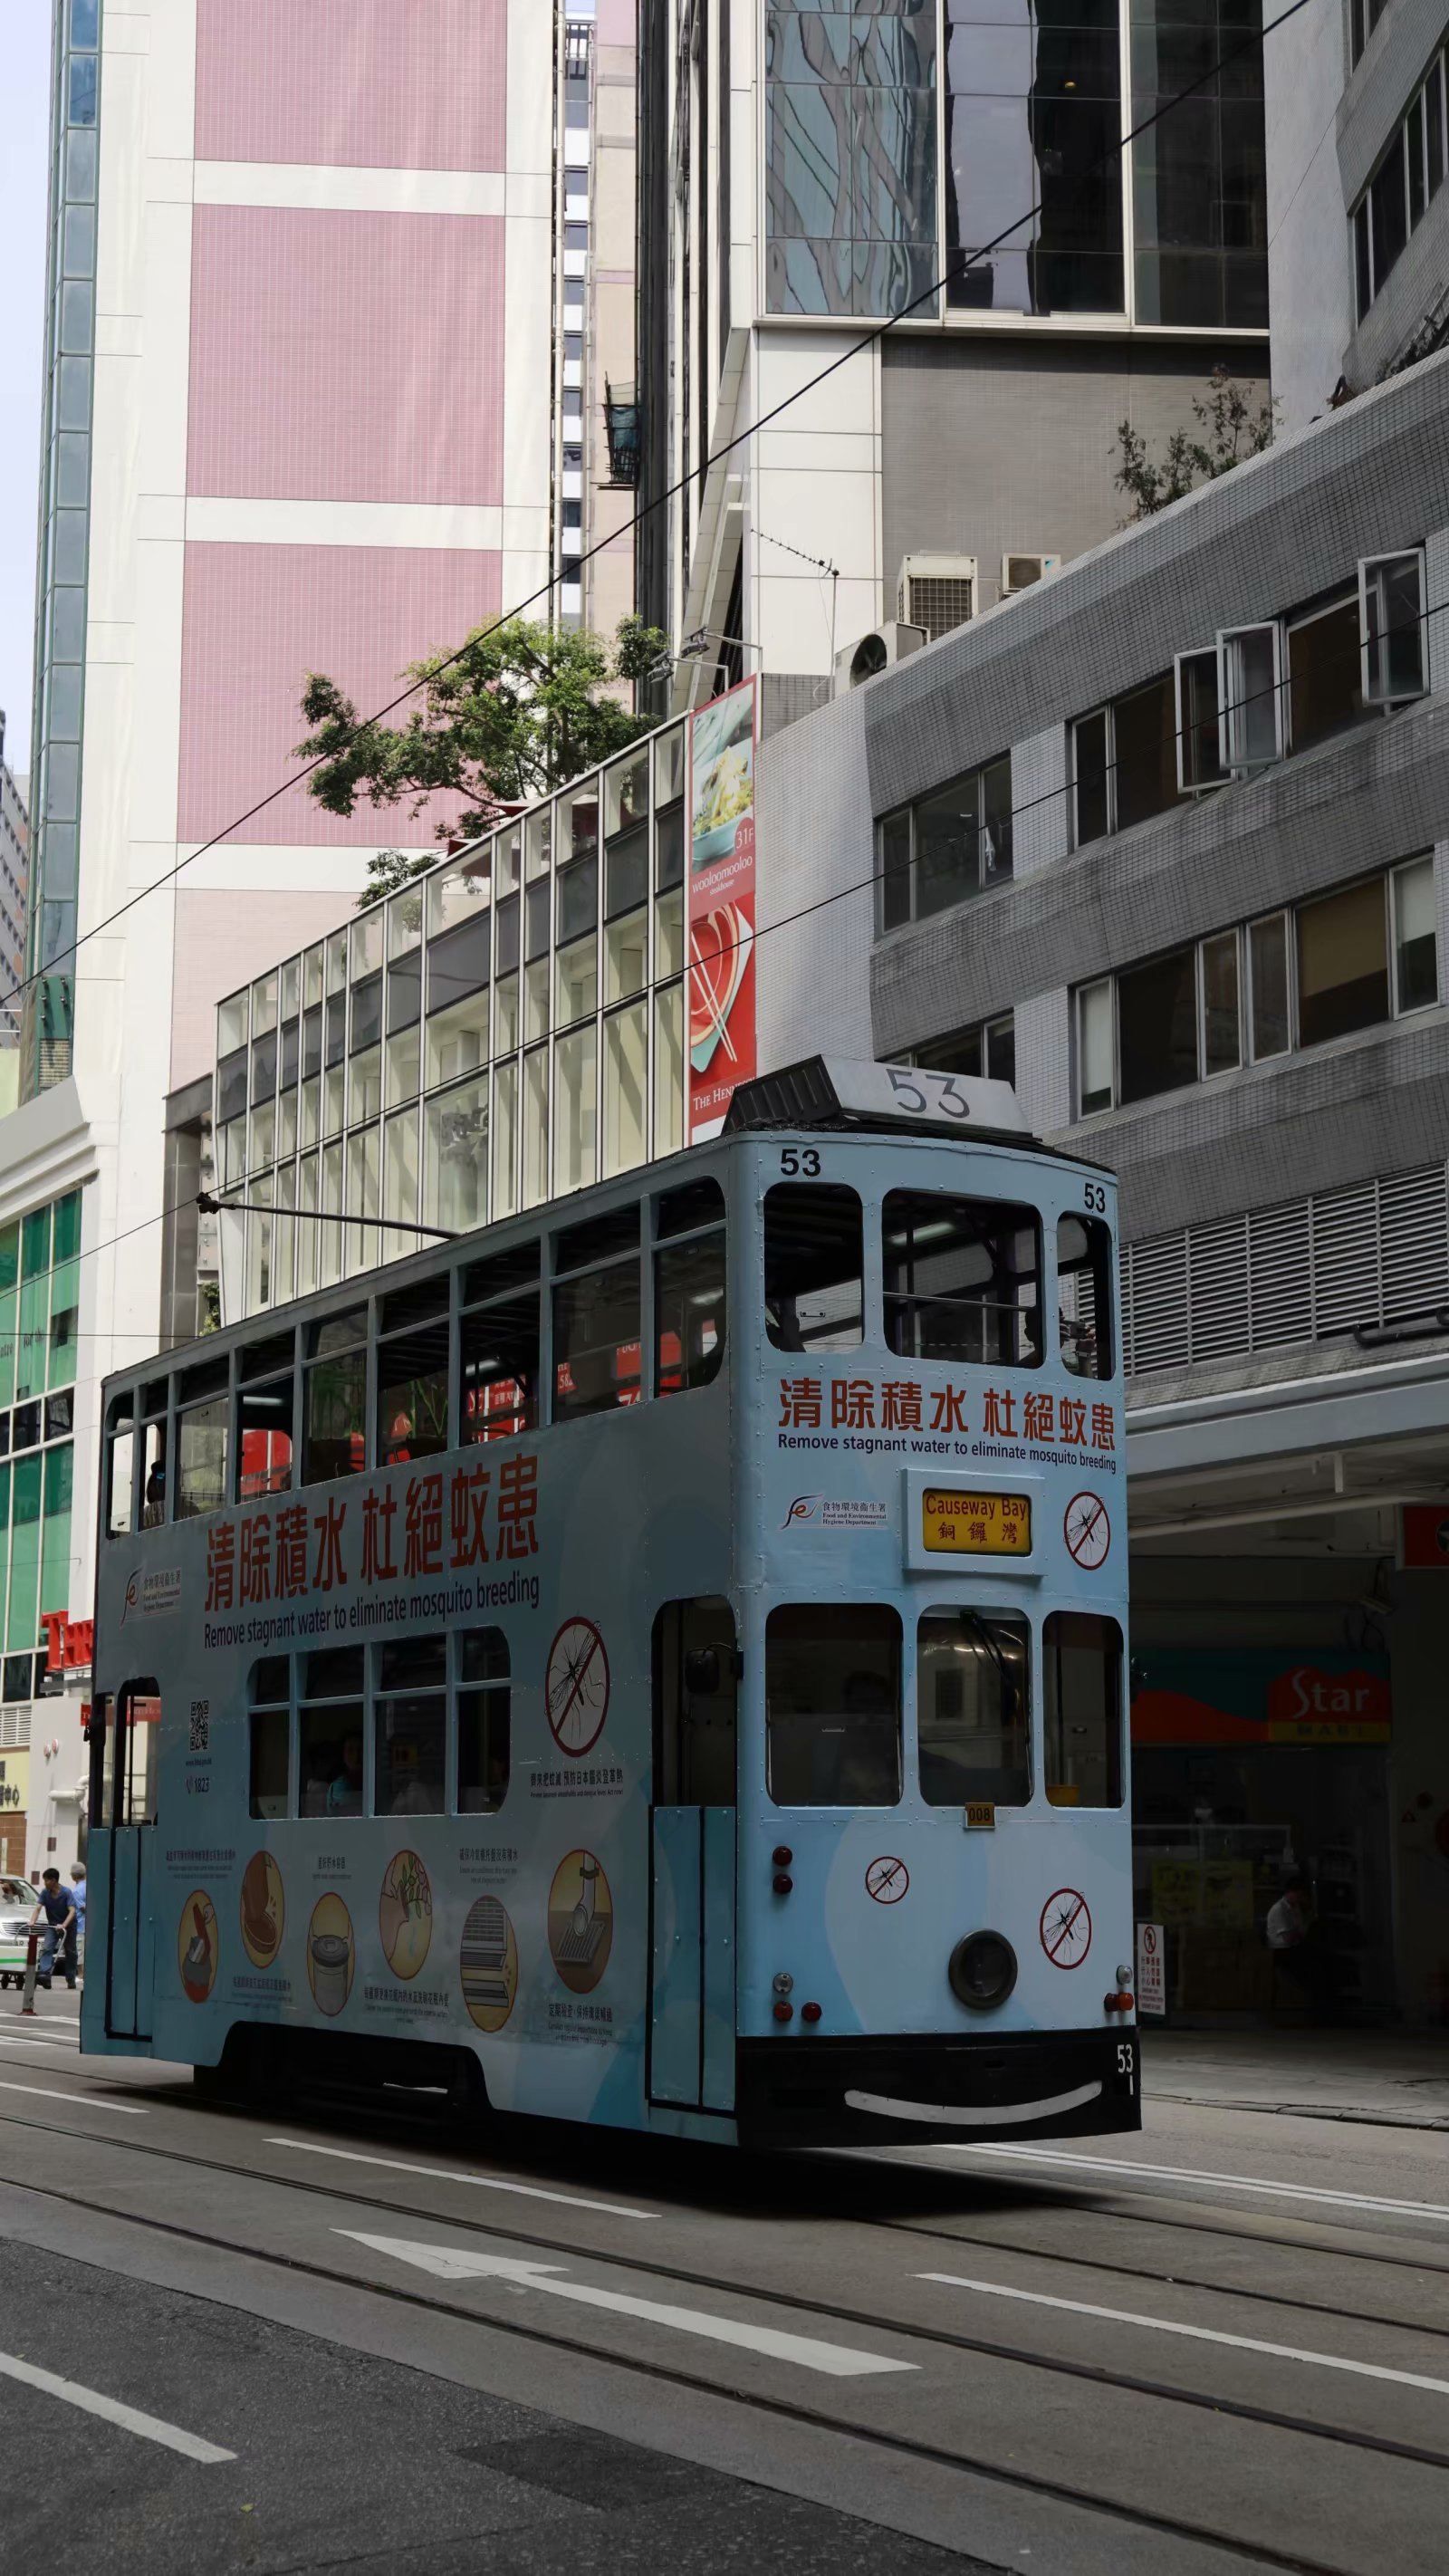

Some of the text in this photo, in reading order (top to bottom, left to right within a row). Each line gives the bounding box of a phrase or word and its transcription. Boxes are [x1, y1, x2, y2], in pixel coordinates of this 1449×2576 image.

[736, 827, 753, 850] 31F
[692, 856, 753, 893] wooloomooloo
[886, 1068, 971, 1119] 53
[780, 1149, 821, 1177] 53
[1084, 1182, 1106, 1214] 53
[778, 1377, 1116, 1451] 清除積水 杜絕蚊患
[778, 1433, 1117, 1475] Remove stagnant water to eliminate mosquito breeding
[926, 1494, 1027, 1522] Causeway Bay
[205, 1453, 539, 1612] 清除積水 杜絕蚊患
[938, 1521, 1018, 1543] 銅鑼灣
[205, 1570, 540, 1649] Remove stagnant water to eliminate mosquito breeding
[1291, 1668, 1370, 1720] Star
[194, 1777, 209, 1793] 1823
[969, 1807, 991, 1821] 008
[1117, 2043, 1133, 2073] 53
